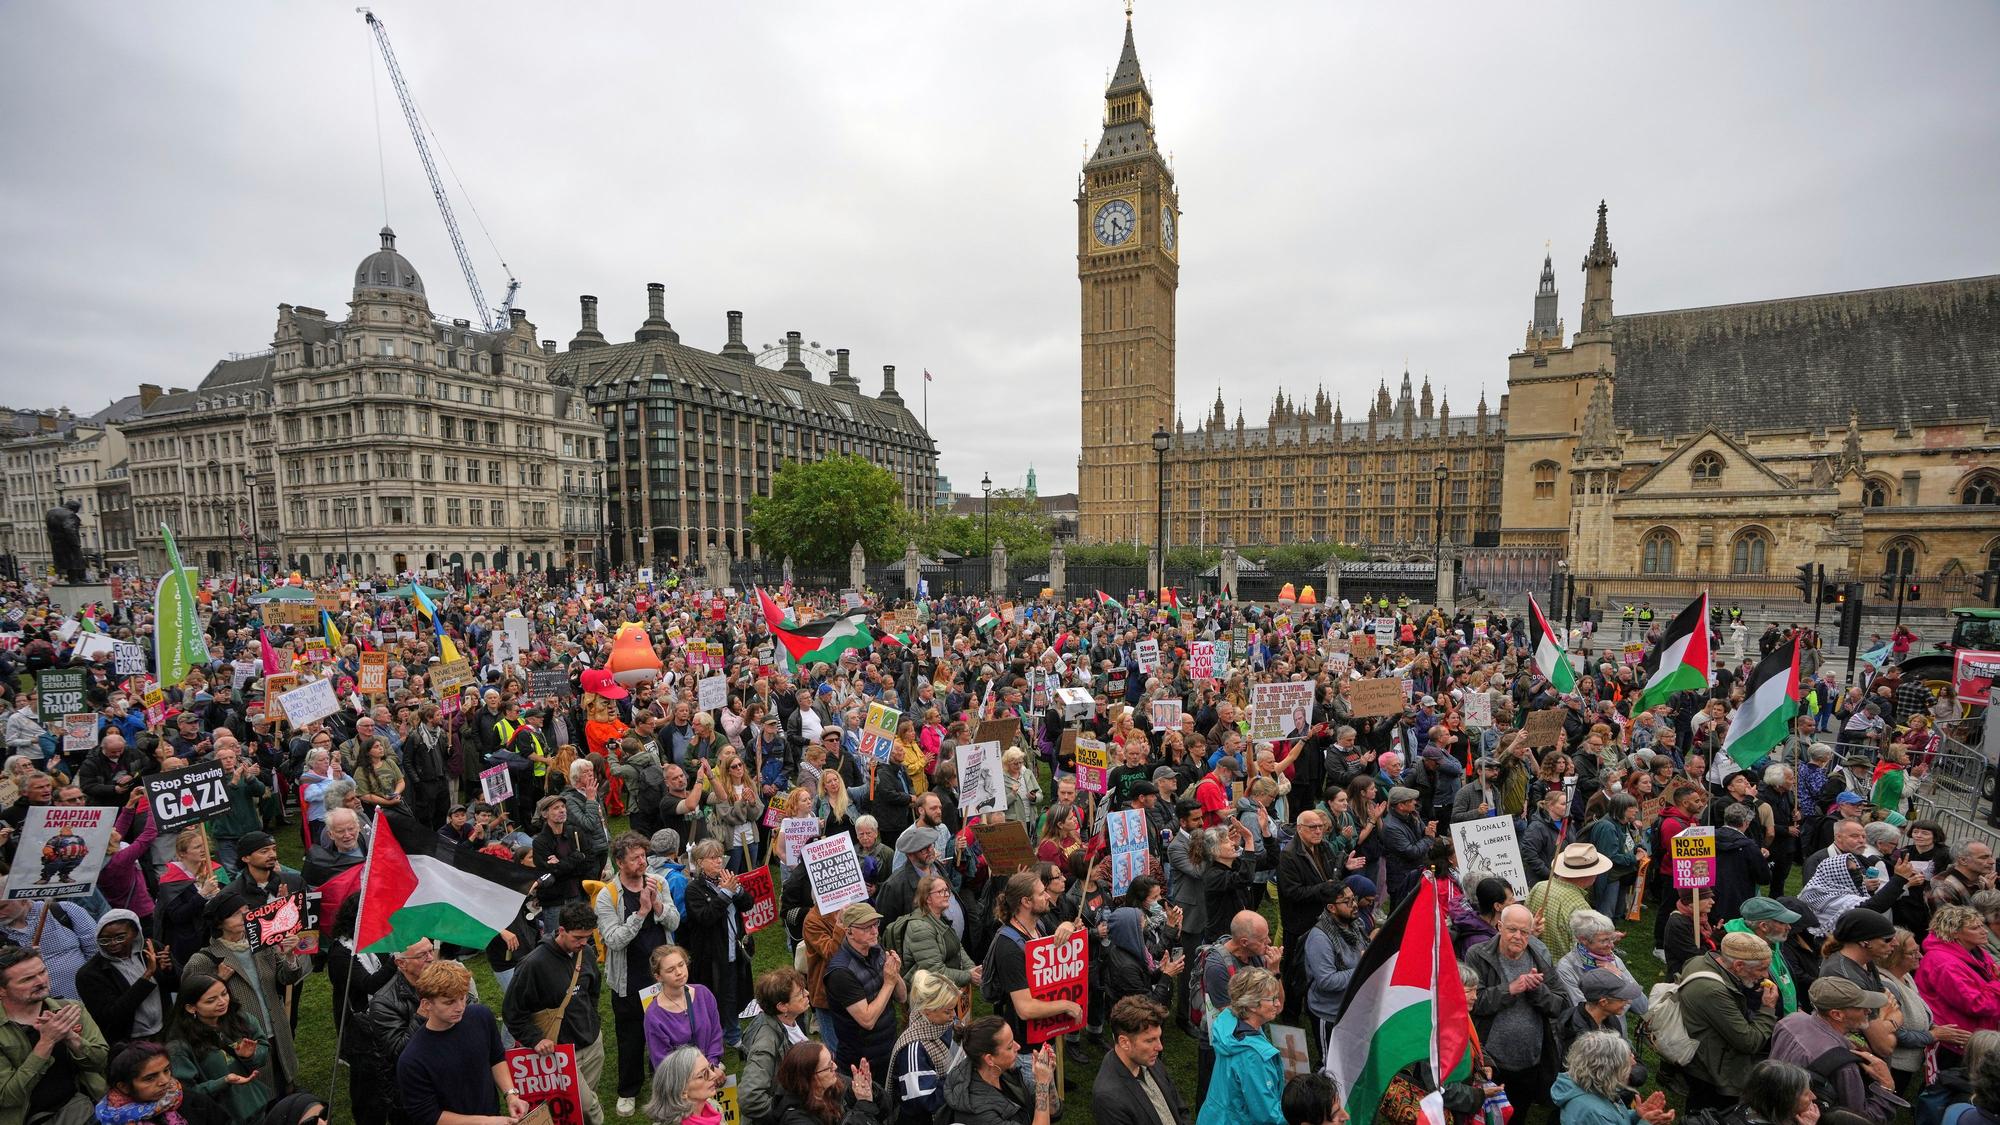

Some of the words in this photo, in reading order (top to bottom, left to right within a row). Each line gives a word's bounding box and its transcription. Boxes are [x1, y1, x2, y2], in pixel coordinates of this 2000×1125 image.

[1194, 657, 1211, 667] YOU
[42, 674, 63, 683] END
[65, 673, 82, 681] THE
[362, 672, 384, 683] NOT
[1191, 667, 1213, 679] TRUMP
[42, 681, 82, 689] GENOCIDE
[42, 692, 82, 705] STOP
[43, 703, 83, 714] TRUMP
[1079, 749, 1086, 757] NO
[1088, 750, 1097, 759] TO
[1078, 756, 1103, 766] RACISM
[1078, 766, 1087, 774] NO
[150, 779, 181, 792] Stop
[183, 768, 223, 785] Starving
[1079, 780, 1101, 791] TRUMP
[155, 779, 229, 821] GAZA
[46, 809, 102, 820] CRAPTAIN
[44, 820, 97, 828] AMERICA
[1475, 821, 1510, 832] DONALD:
[1483, 835, 1512, 845] LIBERATE
[1676, 839, 1690, 847] NO
[1693, 838, 1704, 847] TO
[806, 844, 825, 855] FIGHT
[825, 837, 846, 848] TRUMP
[1130, 842, 1148, 851] NOPE
[1676, 847, 1711, 856] RACISM
[818, 845, 846, 859] STARMER
[810, 863, 822, 872] NO
[823, 859, 833, 868] TO
[834, 852, 853, 863] WAR
[1677, 860, 1691, 868] NO
[813, 860, 856, 881] RACISM
[1496, 868, 1518, 878] LIST!
[1678, 868, 1691, 877] TO
[816, 876, 839, 887] CLIMATE
[839, 869, 857, 880] CHAOS
[1678, 876, 1710, 886] TRUMP
[818, 875, 859, 894] CAPITALISM
[16, 889, 38, 898] FECK
[40, 888, 57, 896] OFF
[58, 884, 85, 895] HOME!
[246, 897, 287, 921] GOLDFISH
[745, 907, 774, 928] STOP
[246, 922, 260, 952] TRUMP
[266, 934, 283, 945] GO
[1032, 938, 1084, 969] STOP
[1032, 959, 1084, 987] TRUMP
[511, 1052, 568, 1078] STOP
[514, 1073, 571, 1095] TRUMP
